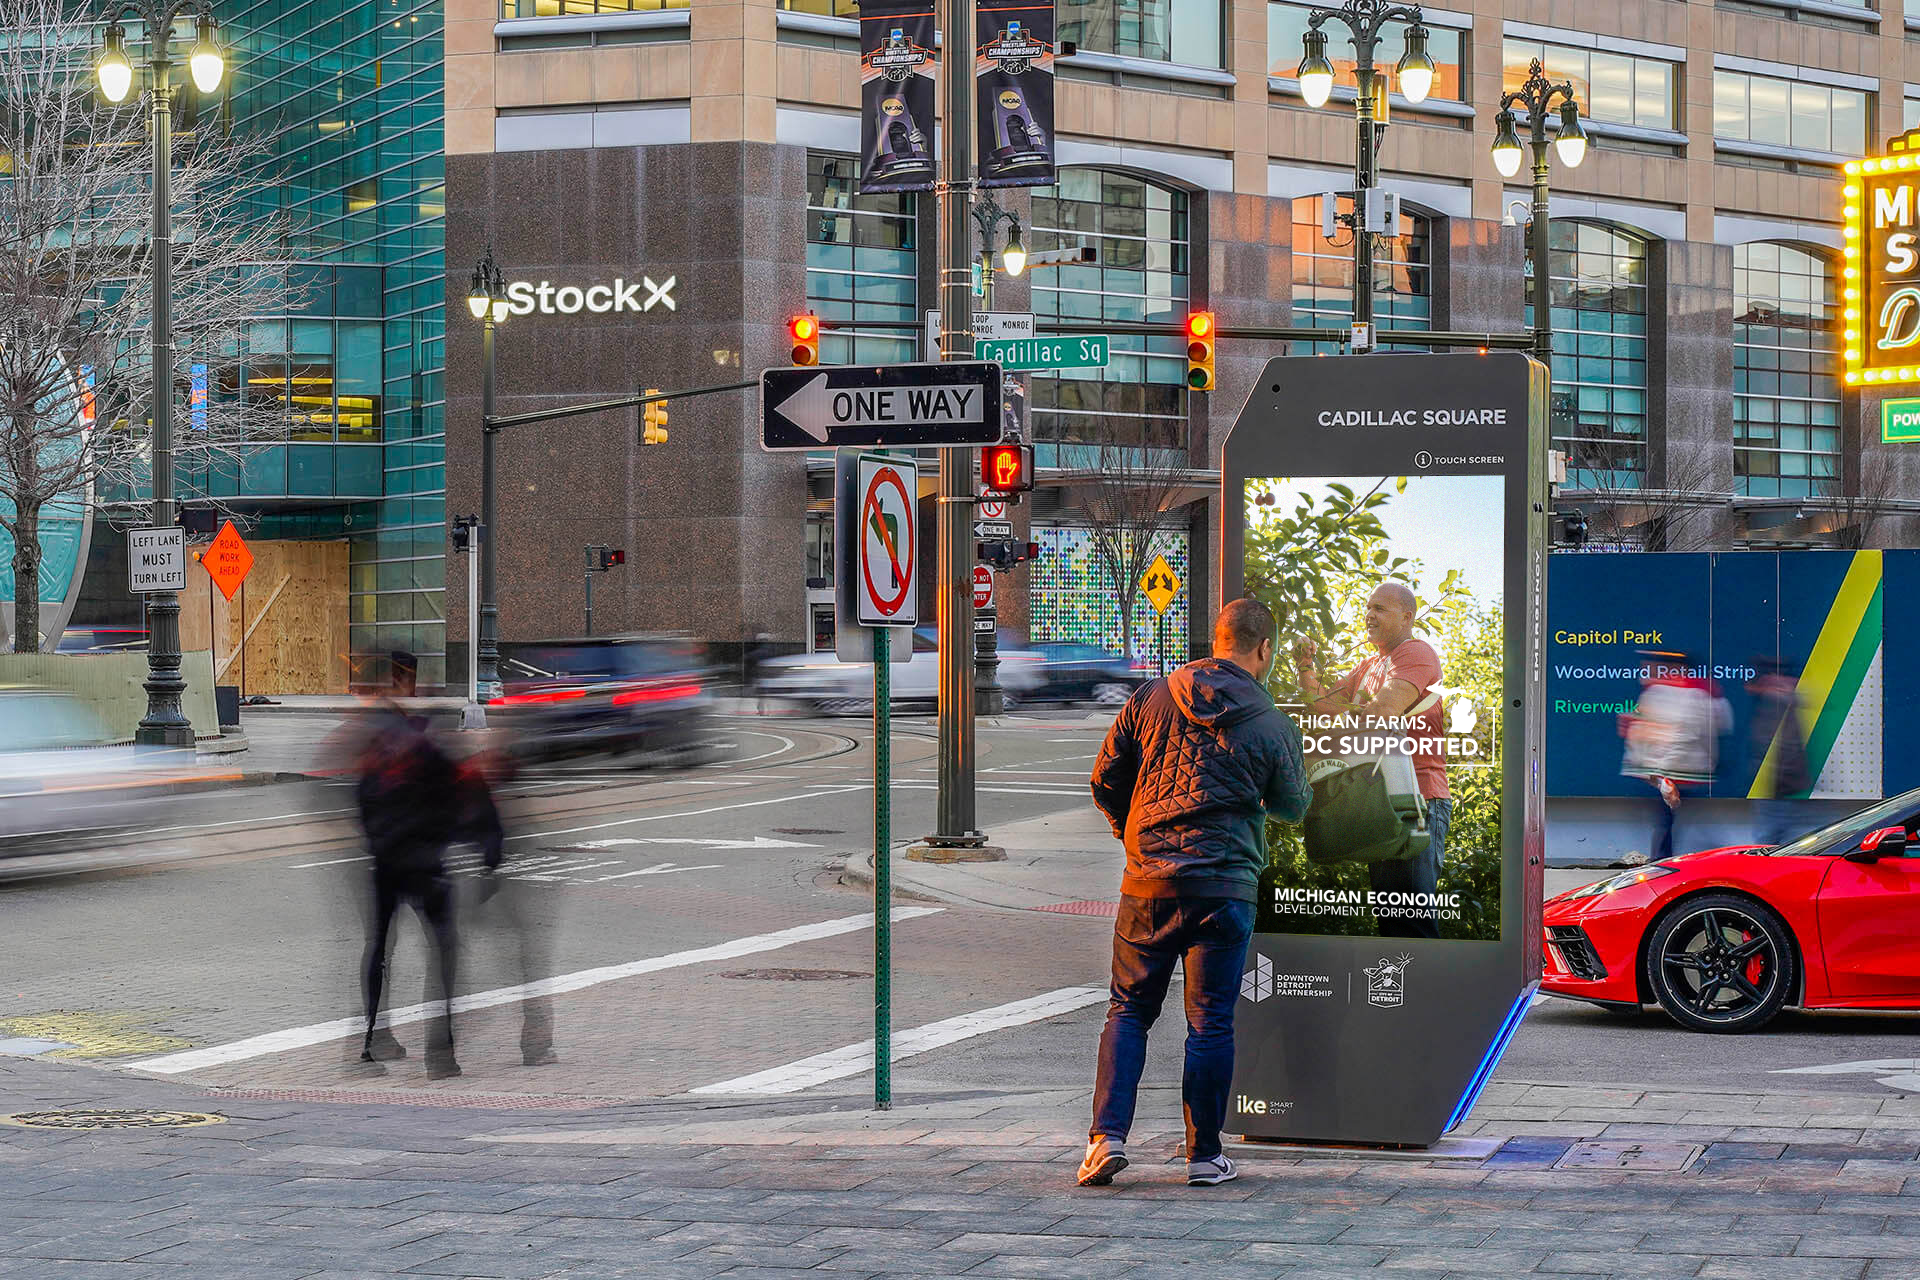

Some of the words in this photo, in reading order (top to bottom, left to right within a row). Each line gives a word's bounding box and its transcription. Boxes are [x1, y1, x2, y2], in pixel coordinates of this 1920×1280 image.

[988, 47, 1041, 56] CHAMPIONSHIPS
[872, 53, 923, 64] CHAMPIONSHIPS
[1875, 185, 1920, 229] M
[507, 275, 676, 315] StockX
[972, 314, 990, 324] LOOP
[1002, 320, 1030, 329] MONROE
[972, 325, 993, 334] ONROE
[983, 341, 1062, 363] Cadillac
[1079, 339, 1101, 363] Sq
[832, 391, 895, 422] ONE
[907, 388, 974, 420] WAY
[1317, 410, 1417, 427] CADILLAC
[1423, 409, 1507, 425] SQUARE
[1434, 456, 1466, 465] TOUCH
[1469, 455, 1505, 464] SCREEN
[983, 526, 994, 534] ONE
[133, 537, 154, 547] LEFT
[158, 535, 180, 545] LANE
[219, 540, 239, 550] ROAD
[142, 553, 172, 566] MUST
[219, 553, 240, 562] WORK
[219, 566, 240, 576] AHEAD
[134, 573, 157, 583] TURN
[161, 572, 182, 582] LEFT
[980, 574, 990, 582] NOT
[1554, 630, 1617, 647] Capitol
[1623, 630, 1663, 644] Park
[1555, 664, 1650, 679] Woodward
[1657, 664, 1706, 679] Retail
[1713, 664, 1756, 681] Strip
[1555, 700, 1640, 713] Riverwalk
[1288, 713, 1358, 729] HIGAN
[1366, 714, 1432, 732] FARMS,
[1303, 735, 1332, 754] DC
[1339, 736, 1484, 756] SUPPORTED.
[1274, 888, 1361, 904] MICHIGAN
[1367, 891, 1460, 908] ECONOMIC
[1274, 903, 1366, 917] DEVELOPMENT
[1371, 906, 1461, 920] CORPORATION
[1277, 974, 1329, 983] DOWNTOWN
[1277, 989, 1333, 997] PARTNERSHIP
[1237, 1095, 1266, 1114] ike
